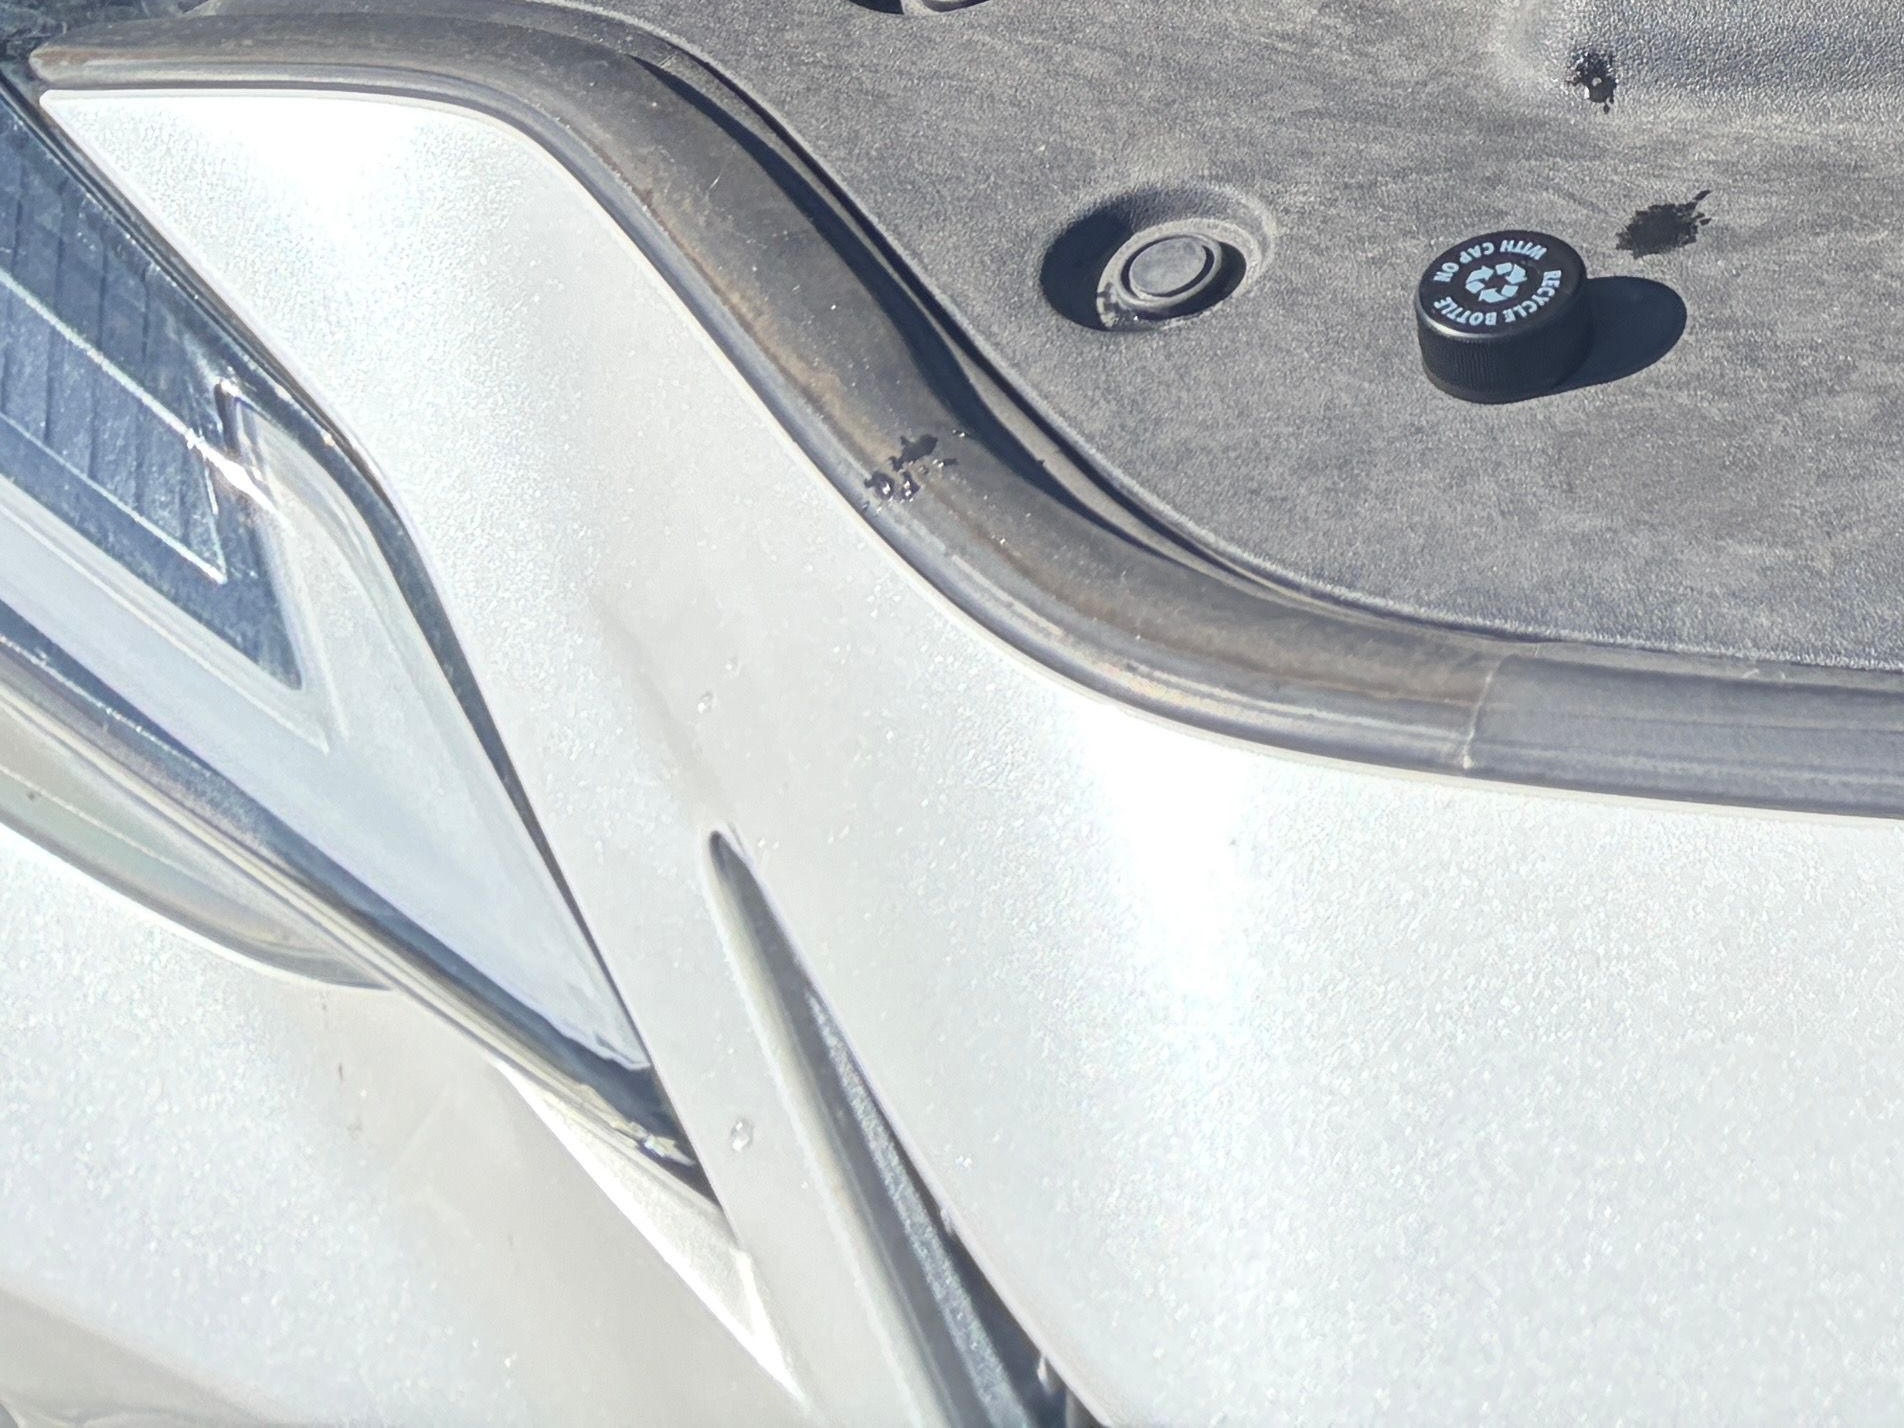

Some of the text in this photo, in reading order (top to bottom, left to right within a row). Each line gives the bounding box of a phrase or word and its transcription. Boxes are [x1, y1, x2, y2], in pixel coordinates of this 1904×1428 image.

[1432, 239, 1547, 284] WITH CAP ON
[1433, 269, 1562, 327] RECYCLE BOTTLE
